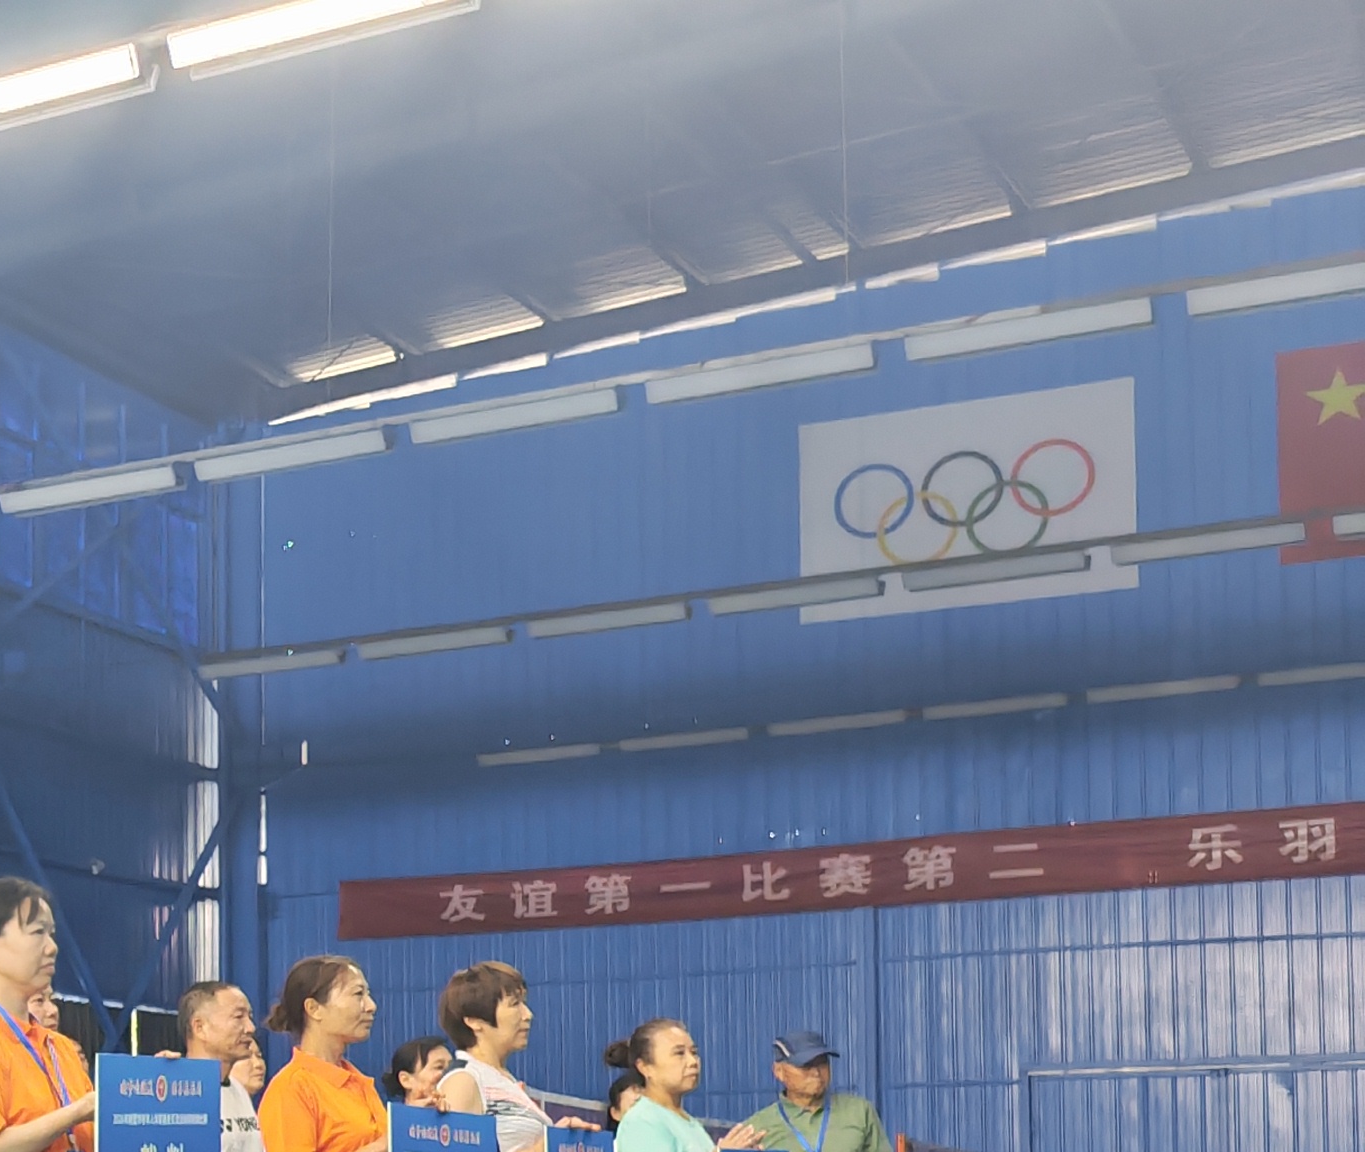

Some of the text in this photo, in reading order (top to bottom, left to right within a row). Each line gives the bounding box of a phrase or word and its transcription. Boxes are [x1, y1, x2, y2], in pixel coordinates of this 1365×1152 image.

[440, 817, 1337, 923] 友谊第一比赛第二 乐羽
